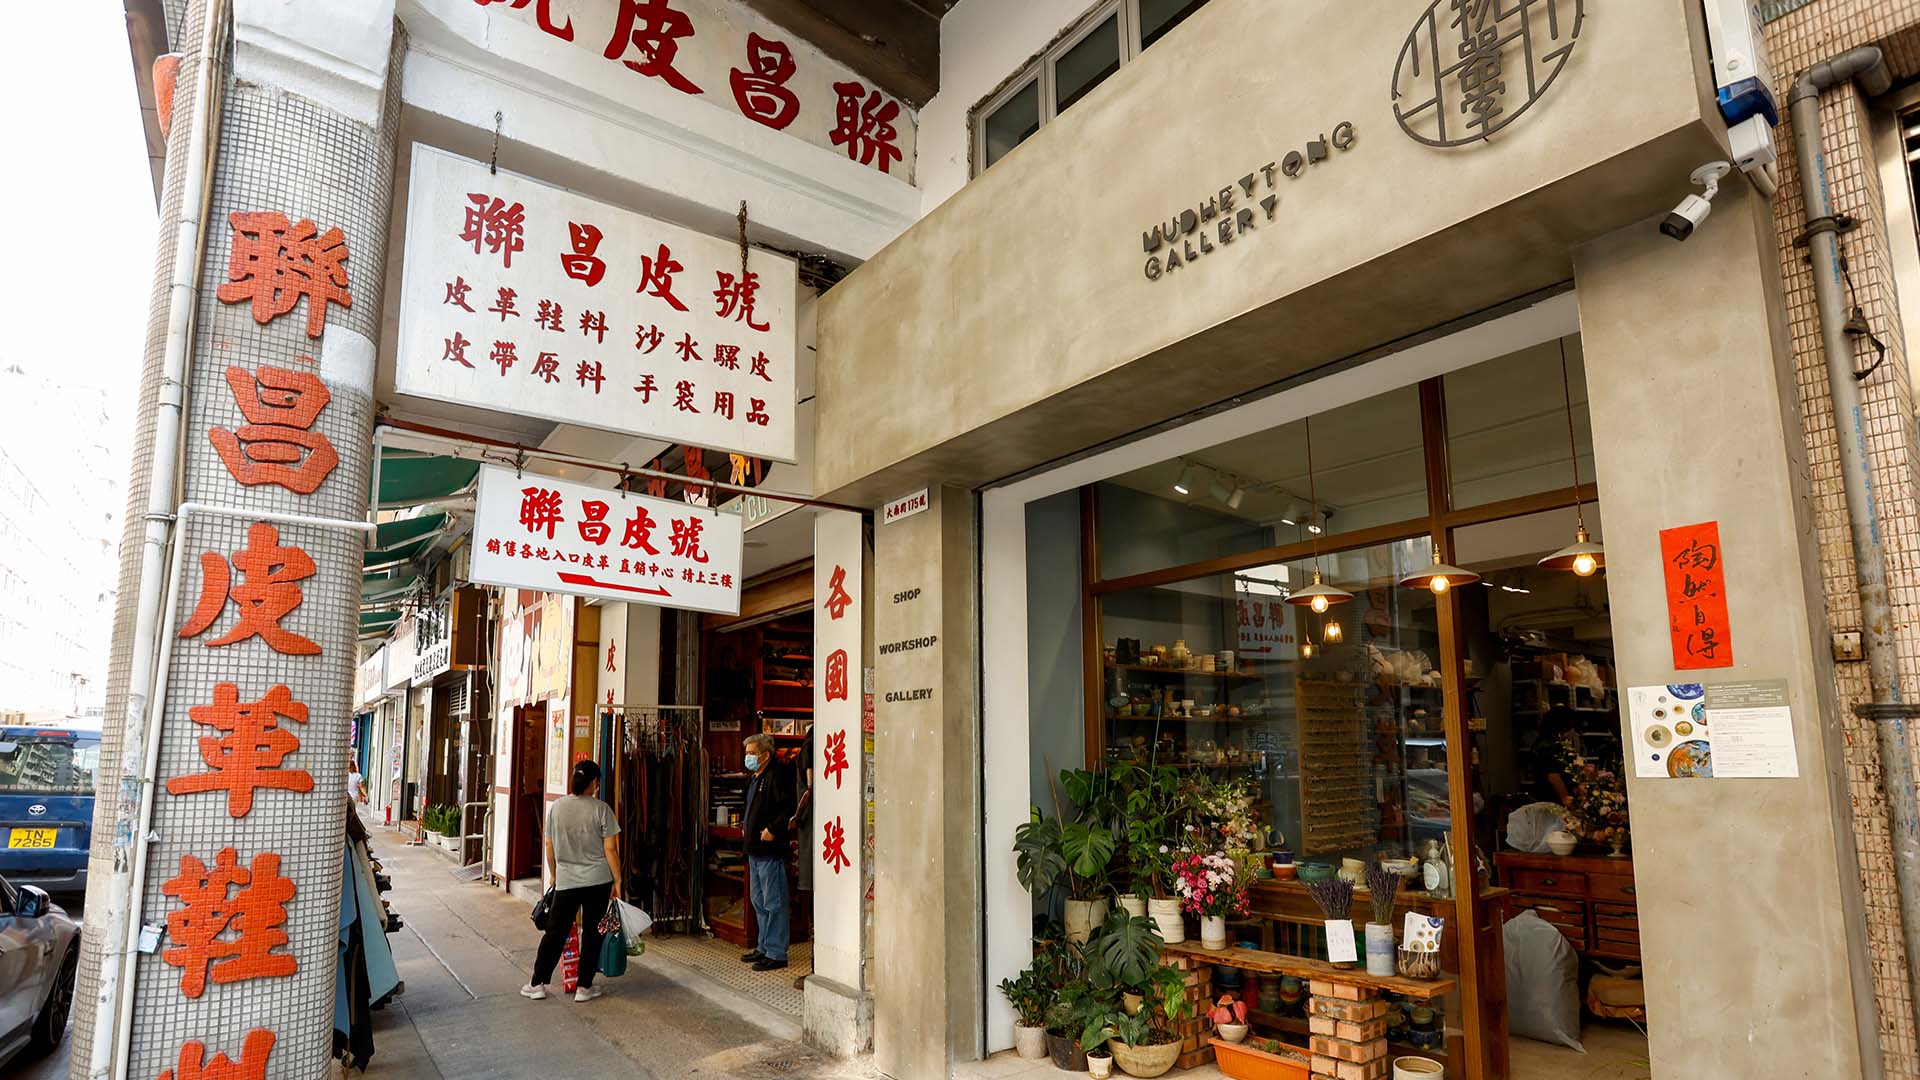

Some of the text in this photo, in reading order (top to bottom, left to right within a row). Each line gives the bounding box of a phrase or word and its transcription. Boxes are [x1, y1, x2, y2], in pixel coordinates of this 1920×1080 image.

[458, 193, 770, 332] 聯昌皮號
[1144, 194, 1276, 280] GALLERY
[445, 276, 609, 343] 皮革鞋料
[442, 331, 770, 426] 皮帶原料 手袋用品
[519, 487, 709, 563] 聯昌皮號
[486, 538, 610, 569] 銷售各地入口皮革
[619, 559, 674, 579] 直銷中心
[893, 588, 921, 604] SHOP
[879, 635, 937, 656] WORKSHOP
[823, 565, 852, 874] 各國洋珠
[885, 687, 933, 703] GALLERY
[12, 838, 52, 848] 7265
[24, 830, 44, 839] TN
